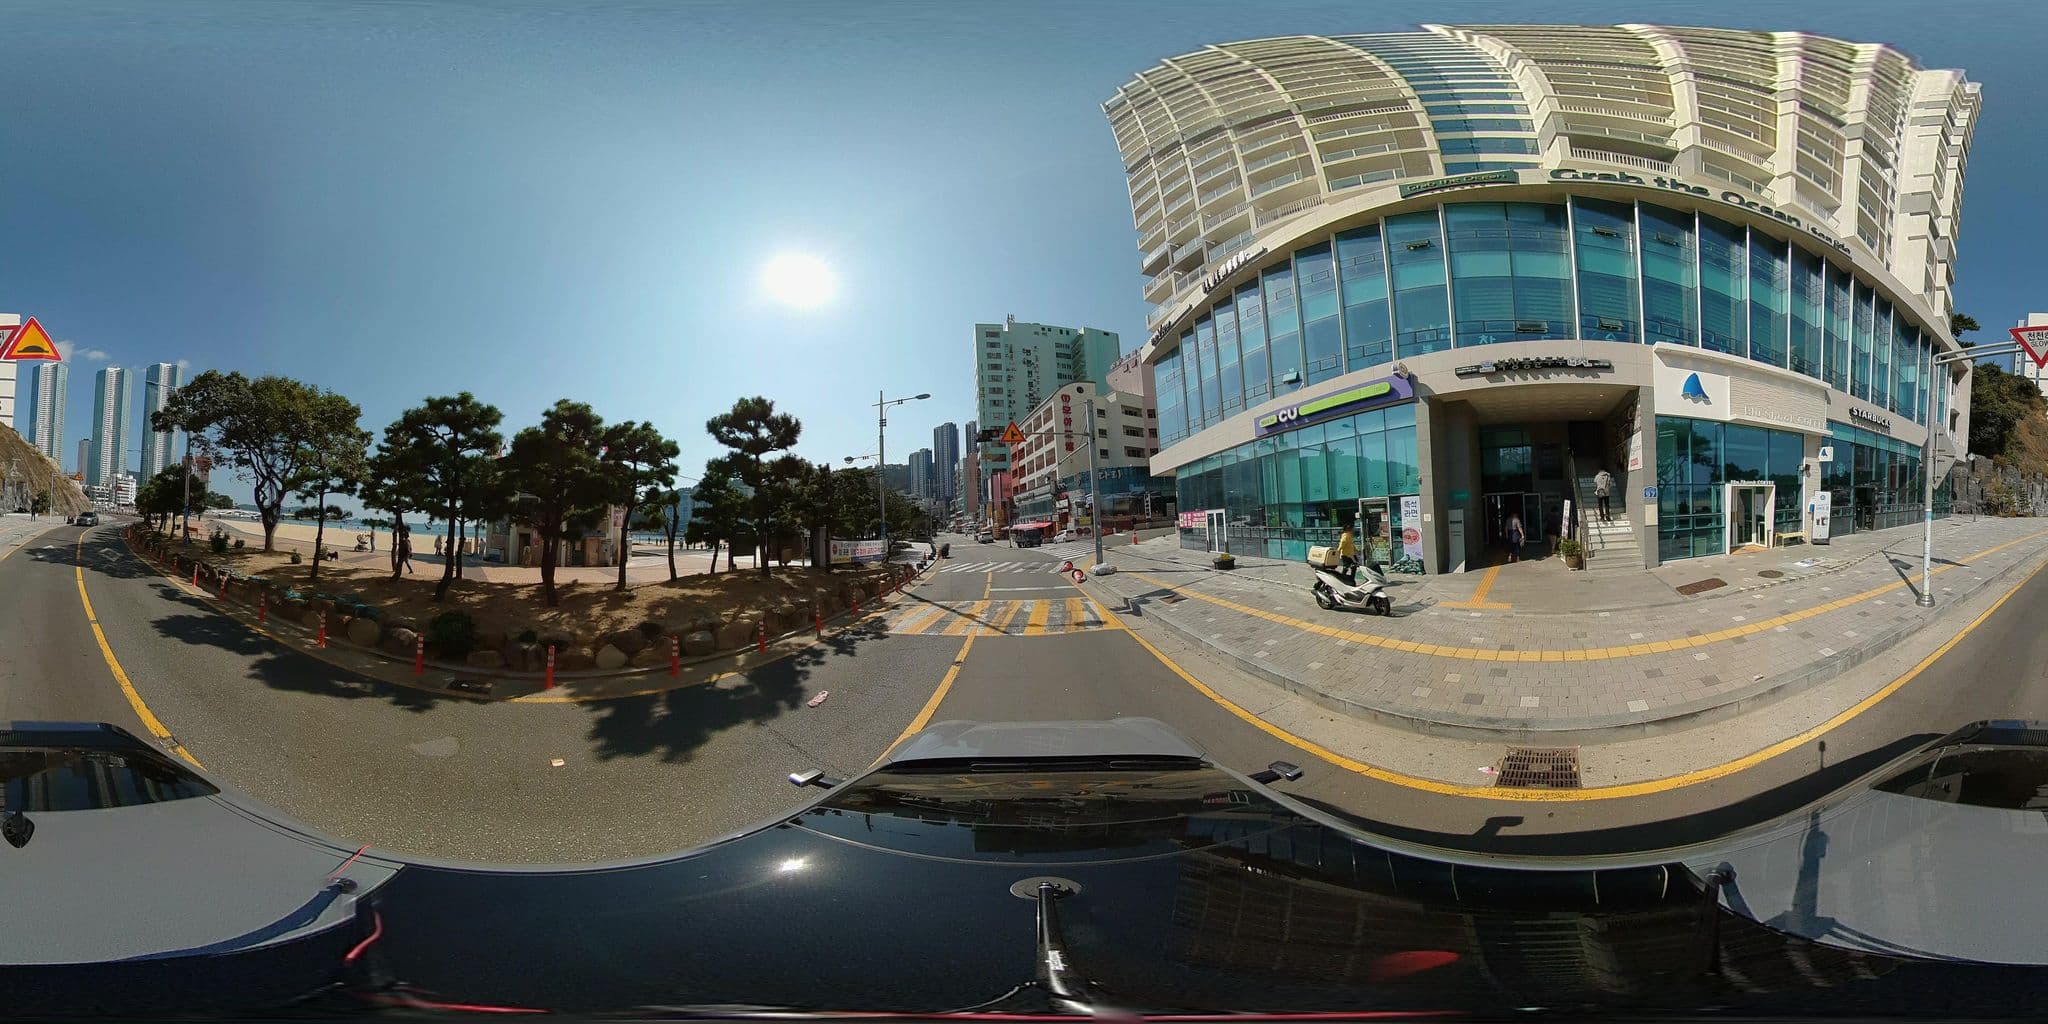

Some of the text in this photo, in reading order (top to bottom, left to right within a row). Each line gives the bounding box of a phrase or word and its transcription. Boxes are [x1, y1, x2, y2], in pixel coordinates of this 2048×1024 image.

[1550, 168, 1645, 185] Grab
[1653, 176, 1711, 197] the
[1721, 191, 1801, 228] Ocean
[1278, 407, 1298, 423] CU
[1404, 509, 1418, 518] 라면
